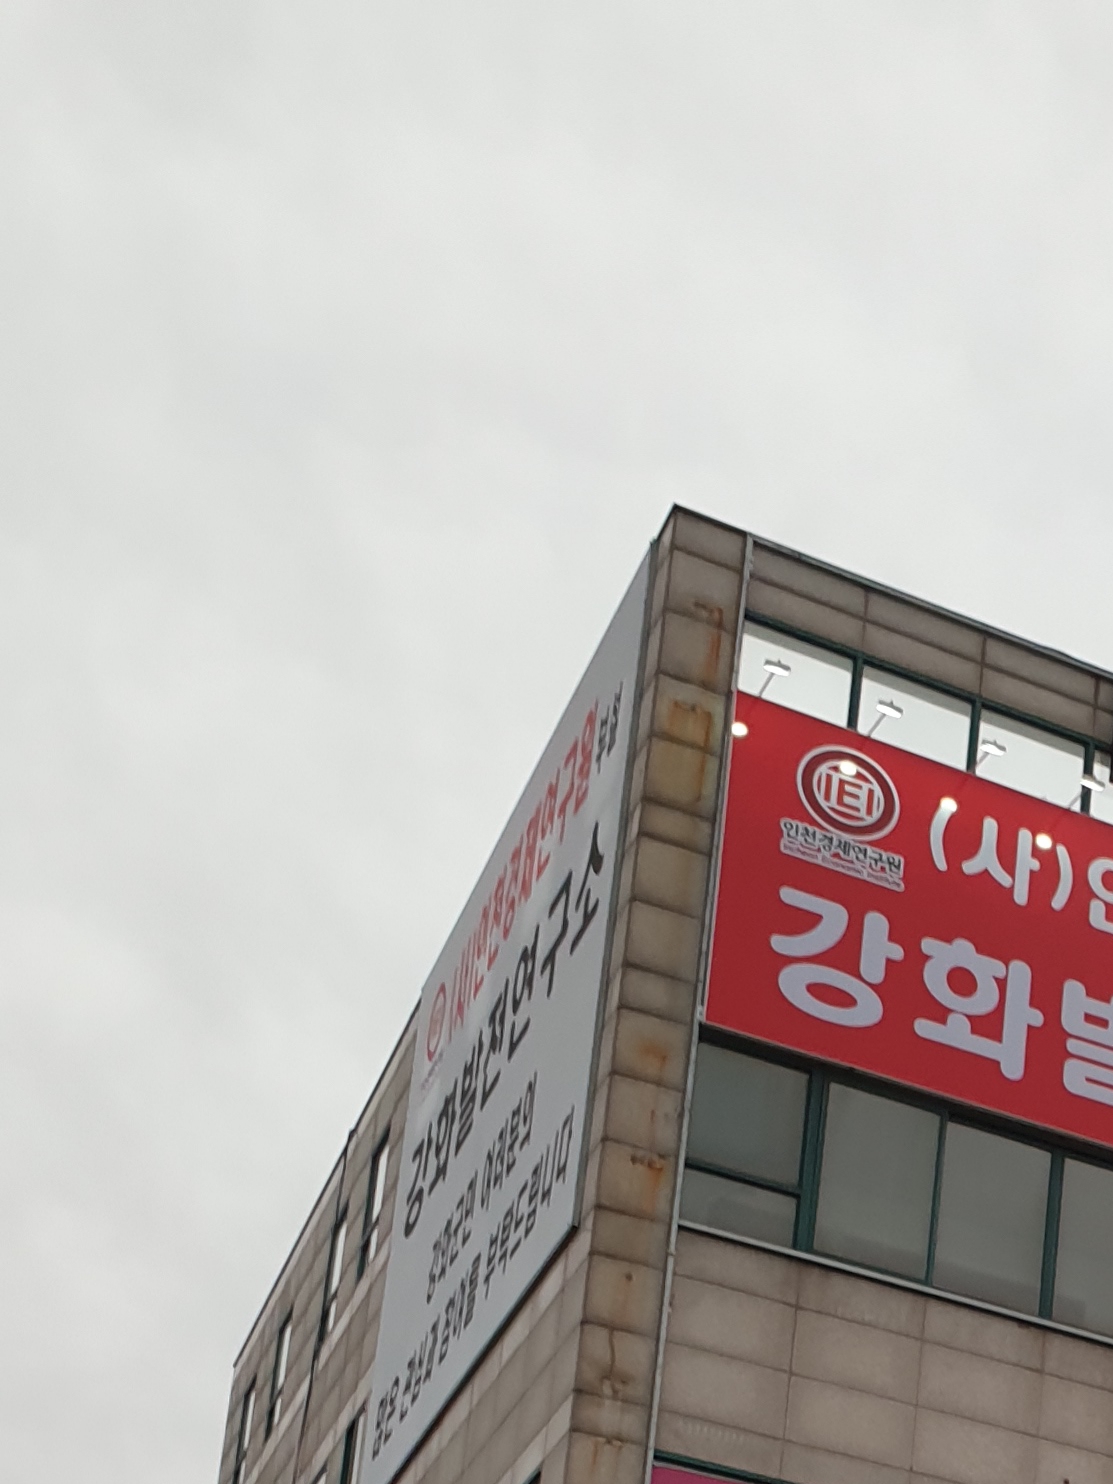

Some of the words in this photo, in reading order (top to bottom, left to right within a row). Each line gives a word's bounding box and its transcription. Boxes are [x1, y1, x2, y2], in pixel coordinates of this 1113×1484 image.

[782, 821, 902, 874] 인천경제연구원
[404, 820, 604, 1239] 강화발전연구소
[399, 1313, 440, 1424] 관심과
[484, 1104, 576, 1300] 부탁드립니다
[426, 1169, 478, 1305] 강화군민
[481, 1070, 538, 1212] 여러분의
